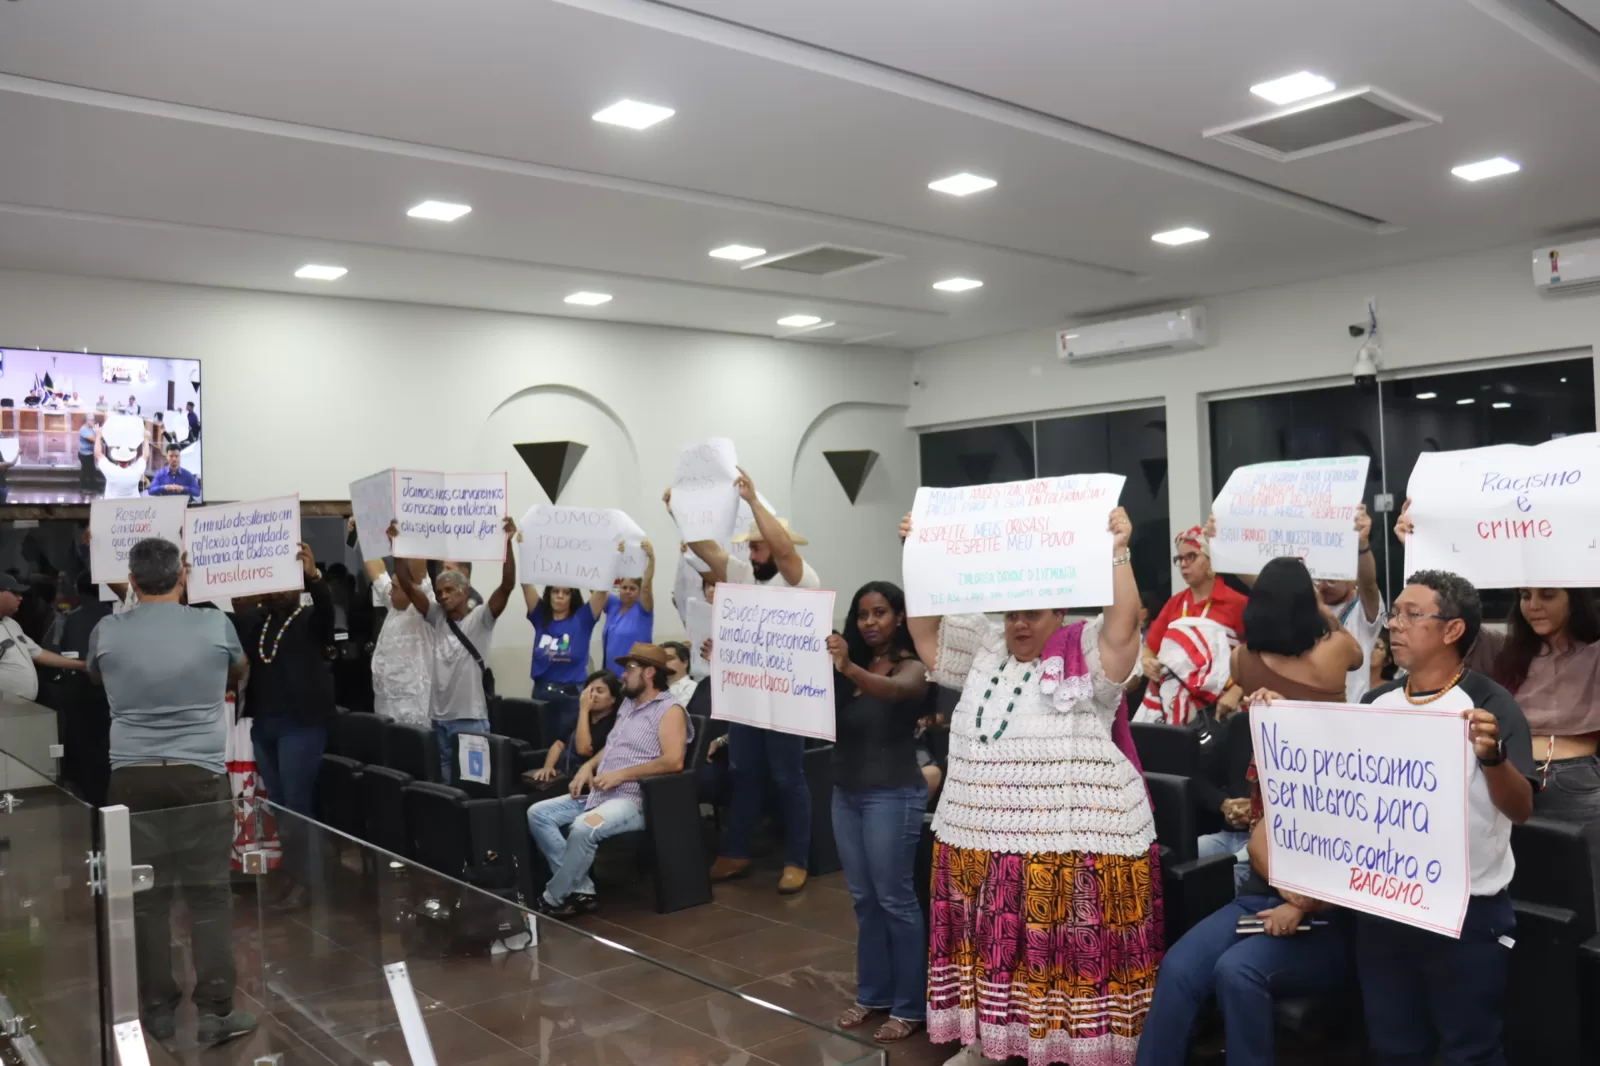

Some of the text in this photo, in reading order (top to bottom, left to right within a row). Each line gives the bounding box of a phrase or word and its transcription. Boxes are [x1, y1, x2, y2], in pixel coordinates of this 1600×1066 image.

[1481, 469, 1581, 492] Racismo
[1517, 490, 1532, 512] é
[453, 519, 475, 541] qual
[918, 524, 967, 545] RESPEITE
[1477, 518, 1553, 539] crime
[232, 546, 244, 561] de
[246, 545, 274, 560] todos
[536, 533, 592, 552] TODOS
[946, 536, 1000, 556] RESPEITE
[1007, 534, 1034, 551] MEU
[1258, 543, 1294, 557] PRETA
[206, 563, 273, 585] brasileiros
[1261, 722, 1438, 792] Não precisamos
[1267, 778, 1299, 809] ser
[1374, 796, 1429, 834] para
[1273, 813, 1352, 864] lutarmos
[1355, 837, 1418, 880] contra
